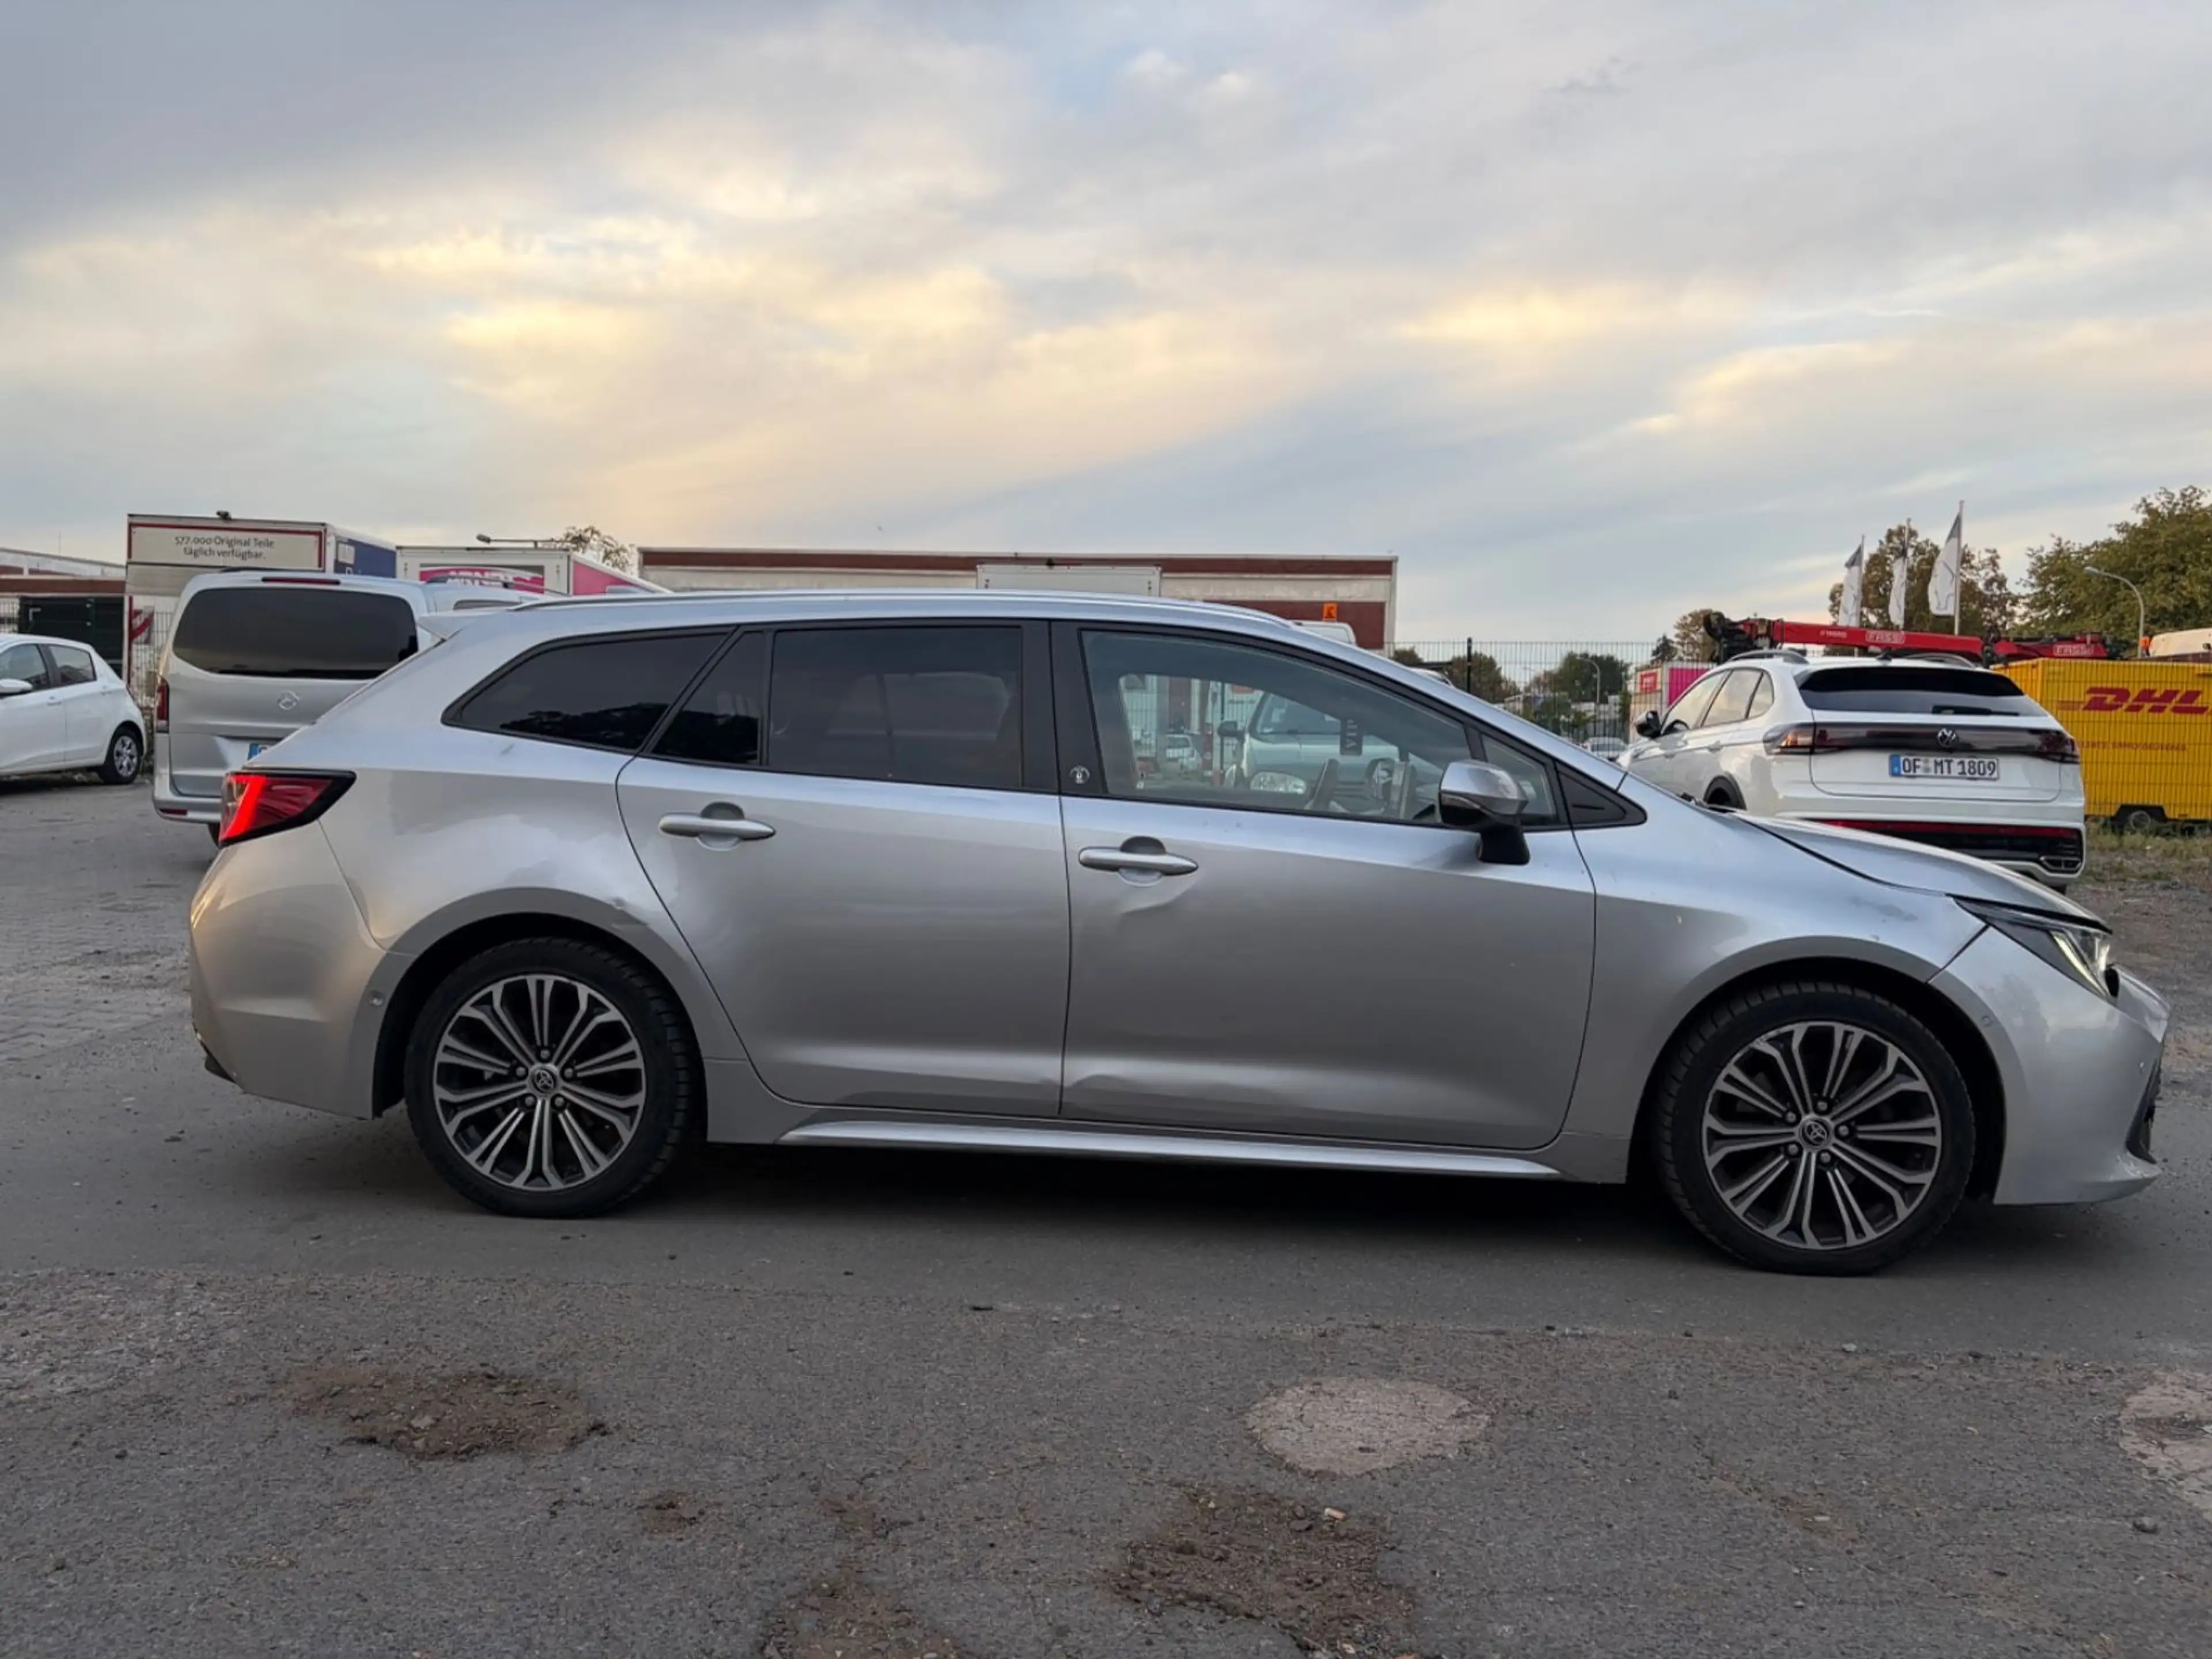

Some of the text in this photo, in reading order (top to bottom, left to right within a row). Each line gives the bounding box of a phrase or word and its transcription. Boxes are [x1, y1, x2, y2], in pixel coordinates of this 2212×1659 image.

[214, 535, 250, 548] Original
[253, 537, 275, 548] Teile
[2082, 686, 2209, 714] DHL
[1902, 757, 1997, 776] OF MT 1809
